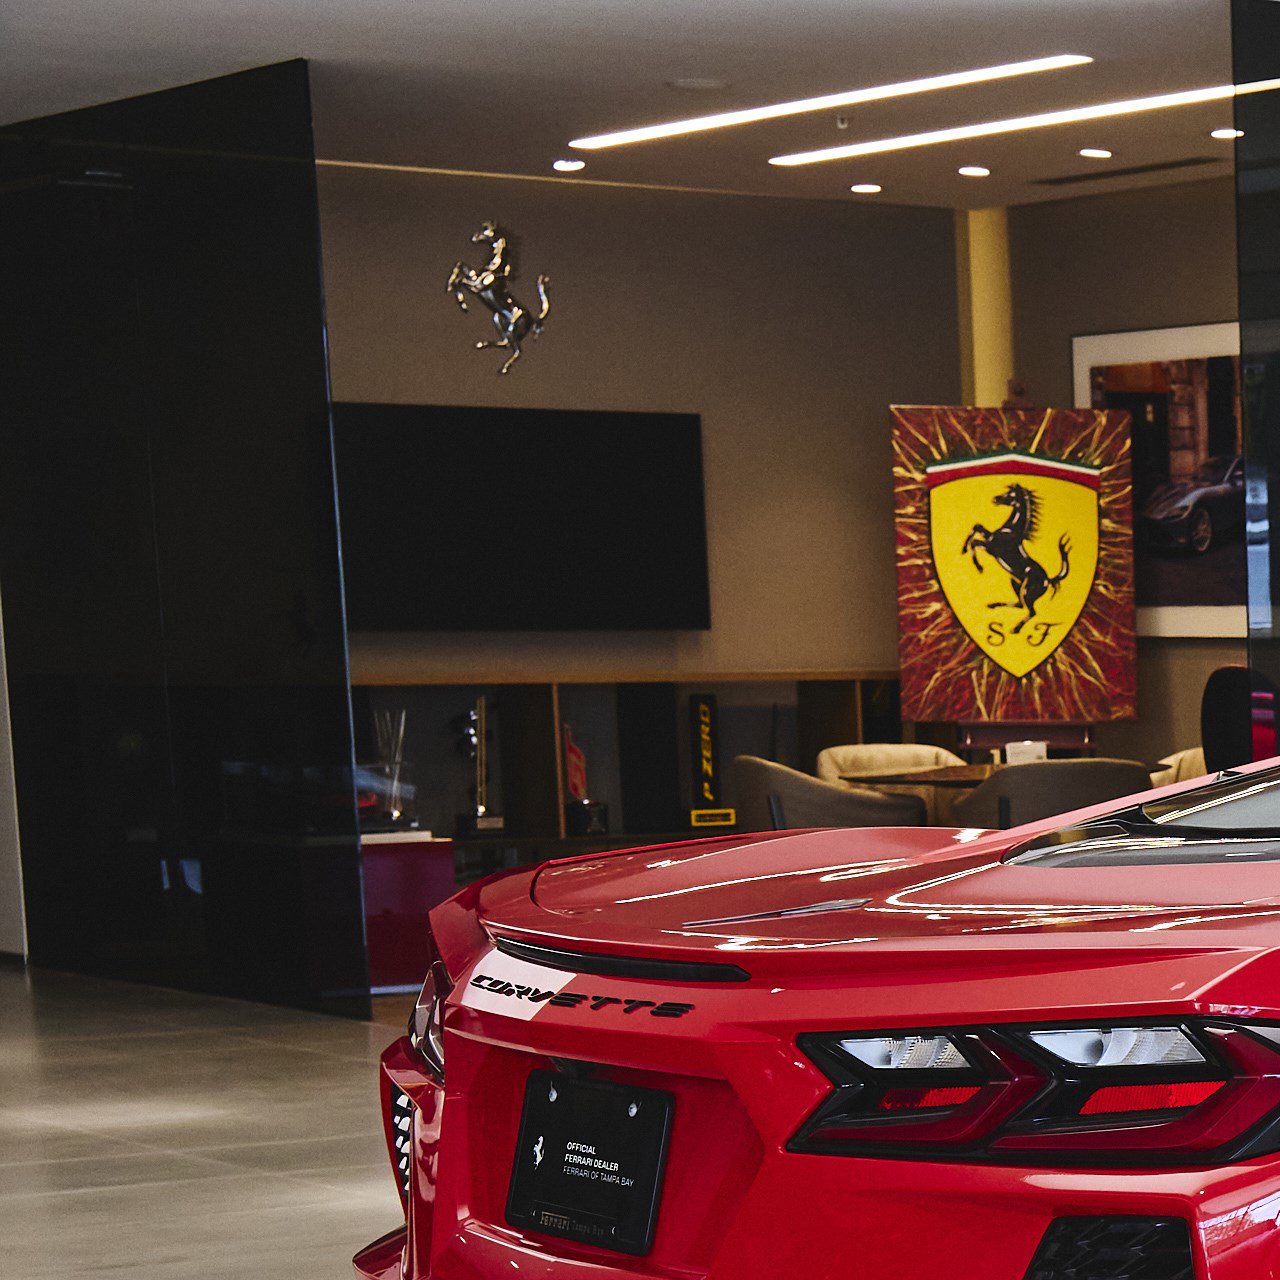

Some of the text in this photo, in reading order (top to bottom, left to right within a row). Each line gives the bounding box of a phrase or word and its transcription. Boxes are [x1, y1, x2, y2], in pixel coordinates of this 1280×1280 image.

[987, 621, 1005, 646] S
[470, 974, 696, 1018] CORVETTE
[566, 1142, 596, 1154] OFFICIAL
[564, 1153, 619, 1171] FERRARI DEALER
[563, 1165, 634, 1187] FERRARI OF TAMPA BAY
[540, 1211, 570, 1230] Ferrari
